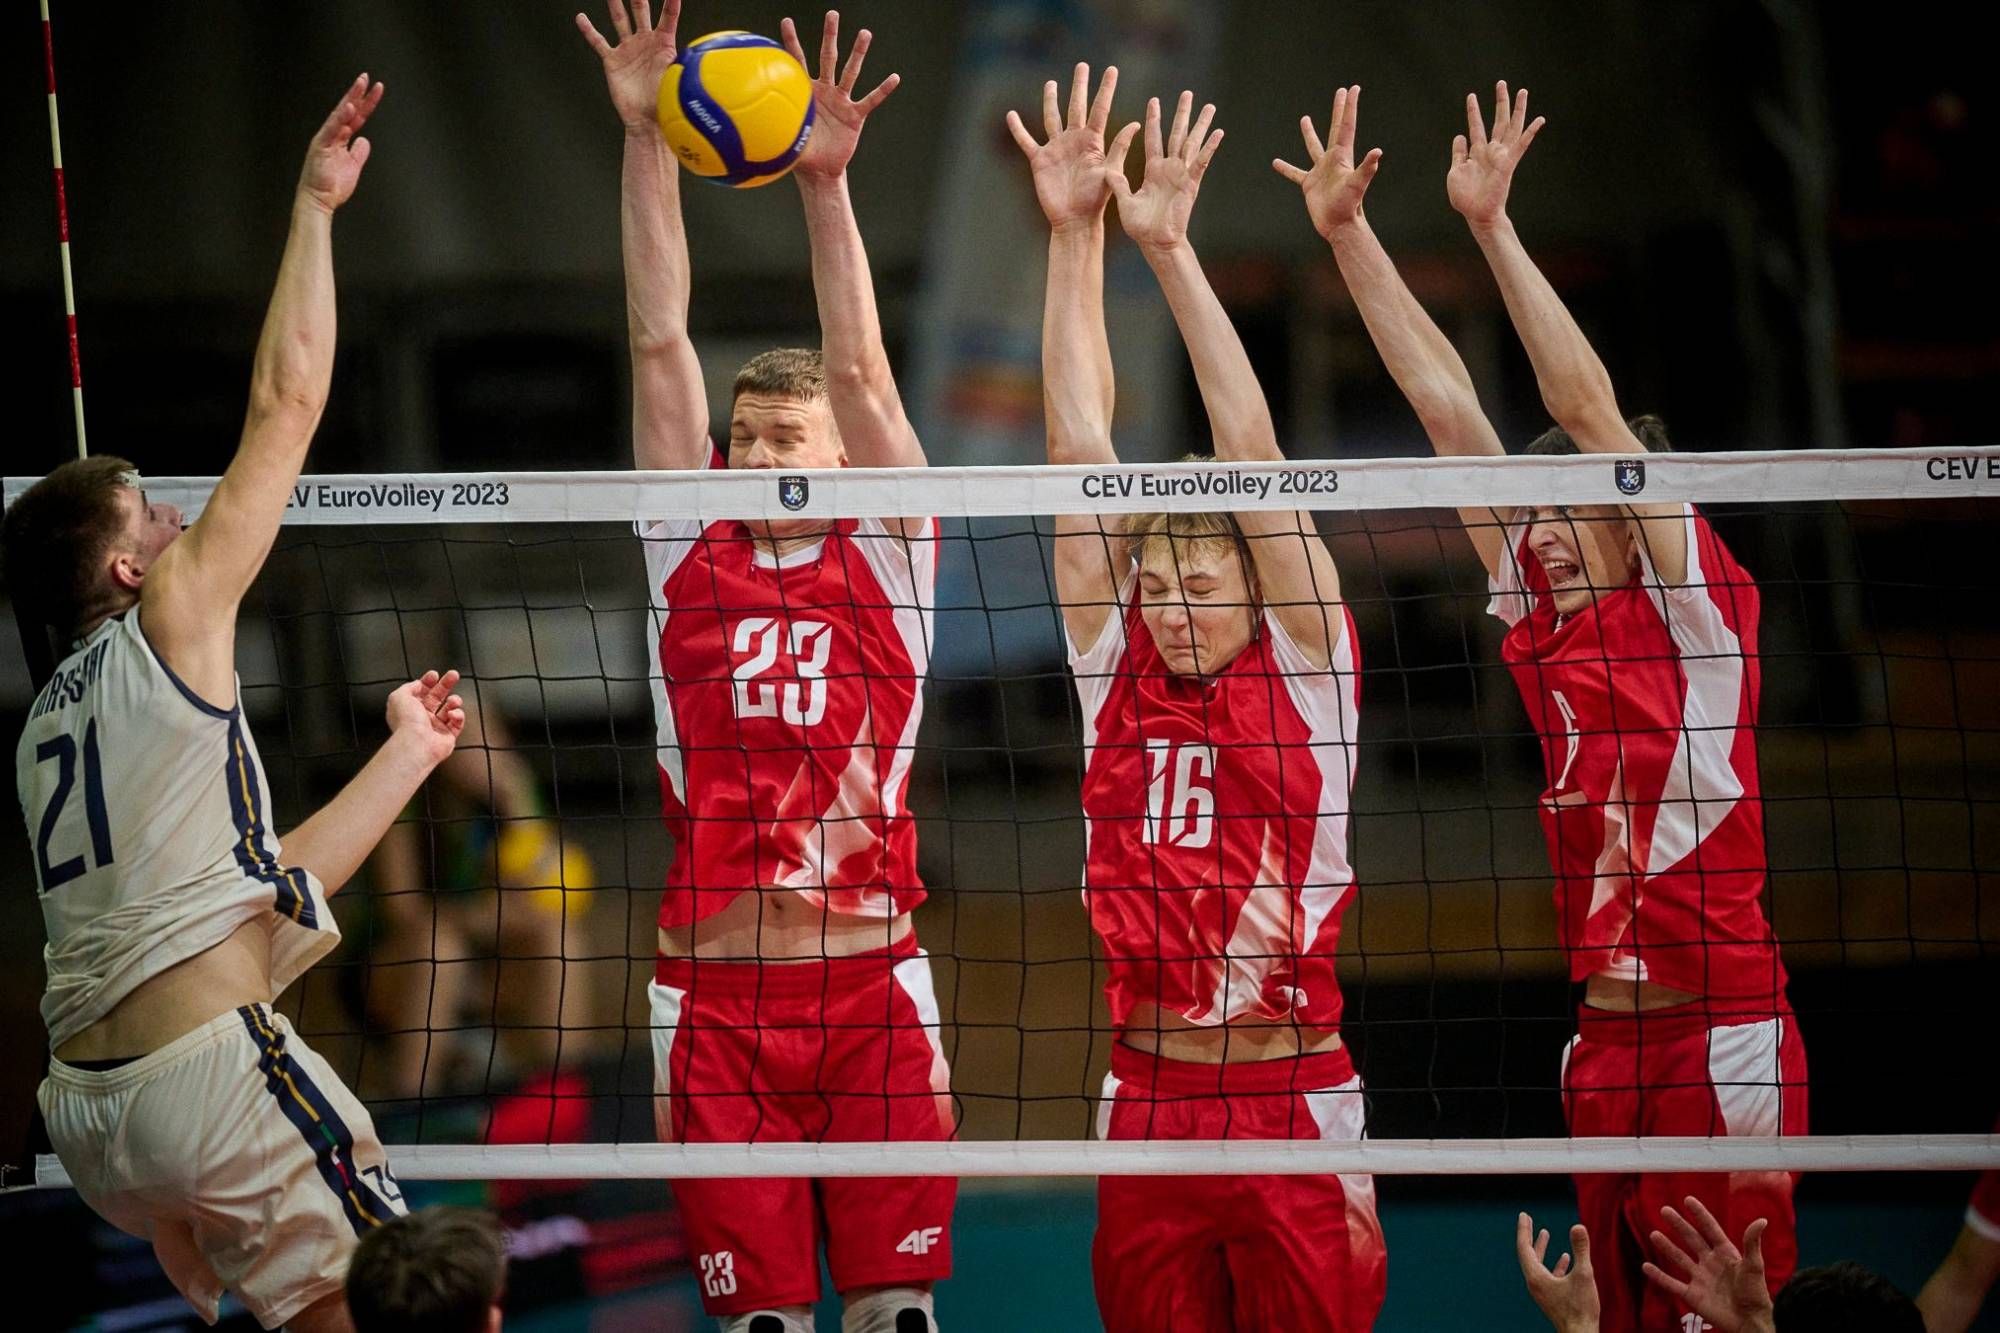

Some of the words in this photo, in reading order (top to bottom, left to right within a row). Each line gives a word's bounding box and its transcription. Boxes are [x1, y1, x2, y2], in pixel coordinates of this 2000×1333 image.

[1081, 474, 1134, 498] CEV
[1140, 470, 1272, 500] EuroVolley
[1278, 469, 1339, 494] 2023
[1926, 456, 1980, 481] CEV
[317, 483, 445, 512] EuroVolley
[451, 482, 510, 506] 2023
[731, 617, 833, 727] 23
[36, 714, 115, 894] 21
[1141, 738, 1219, 849] 16
[896, 1226, 943, 1255] 4F
[699, 1250, 738, 1297] 23
